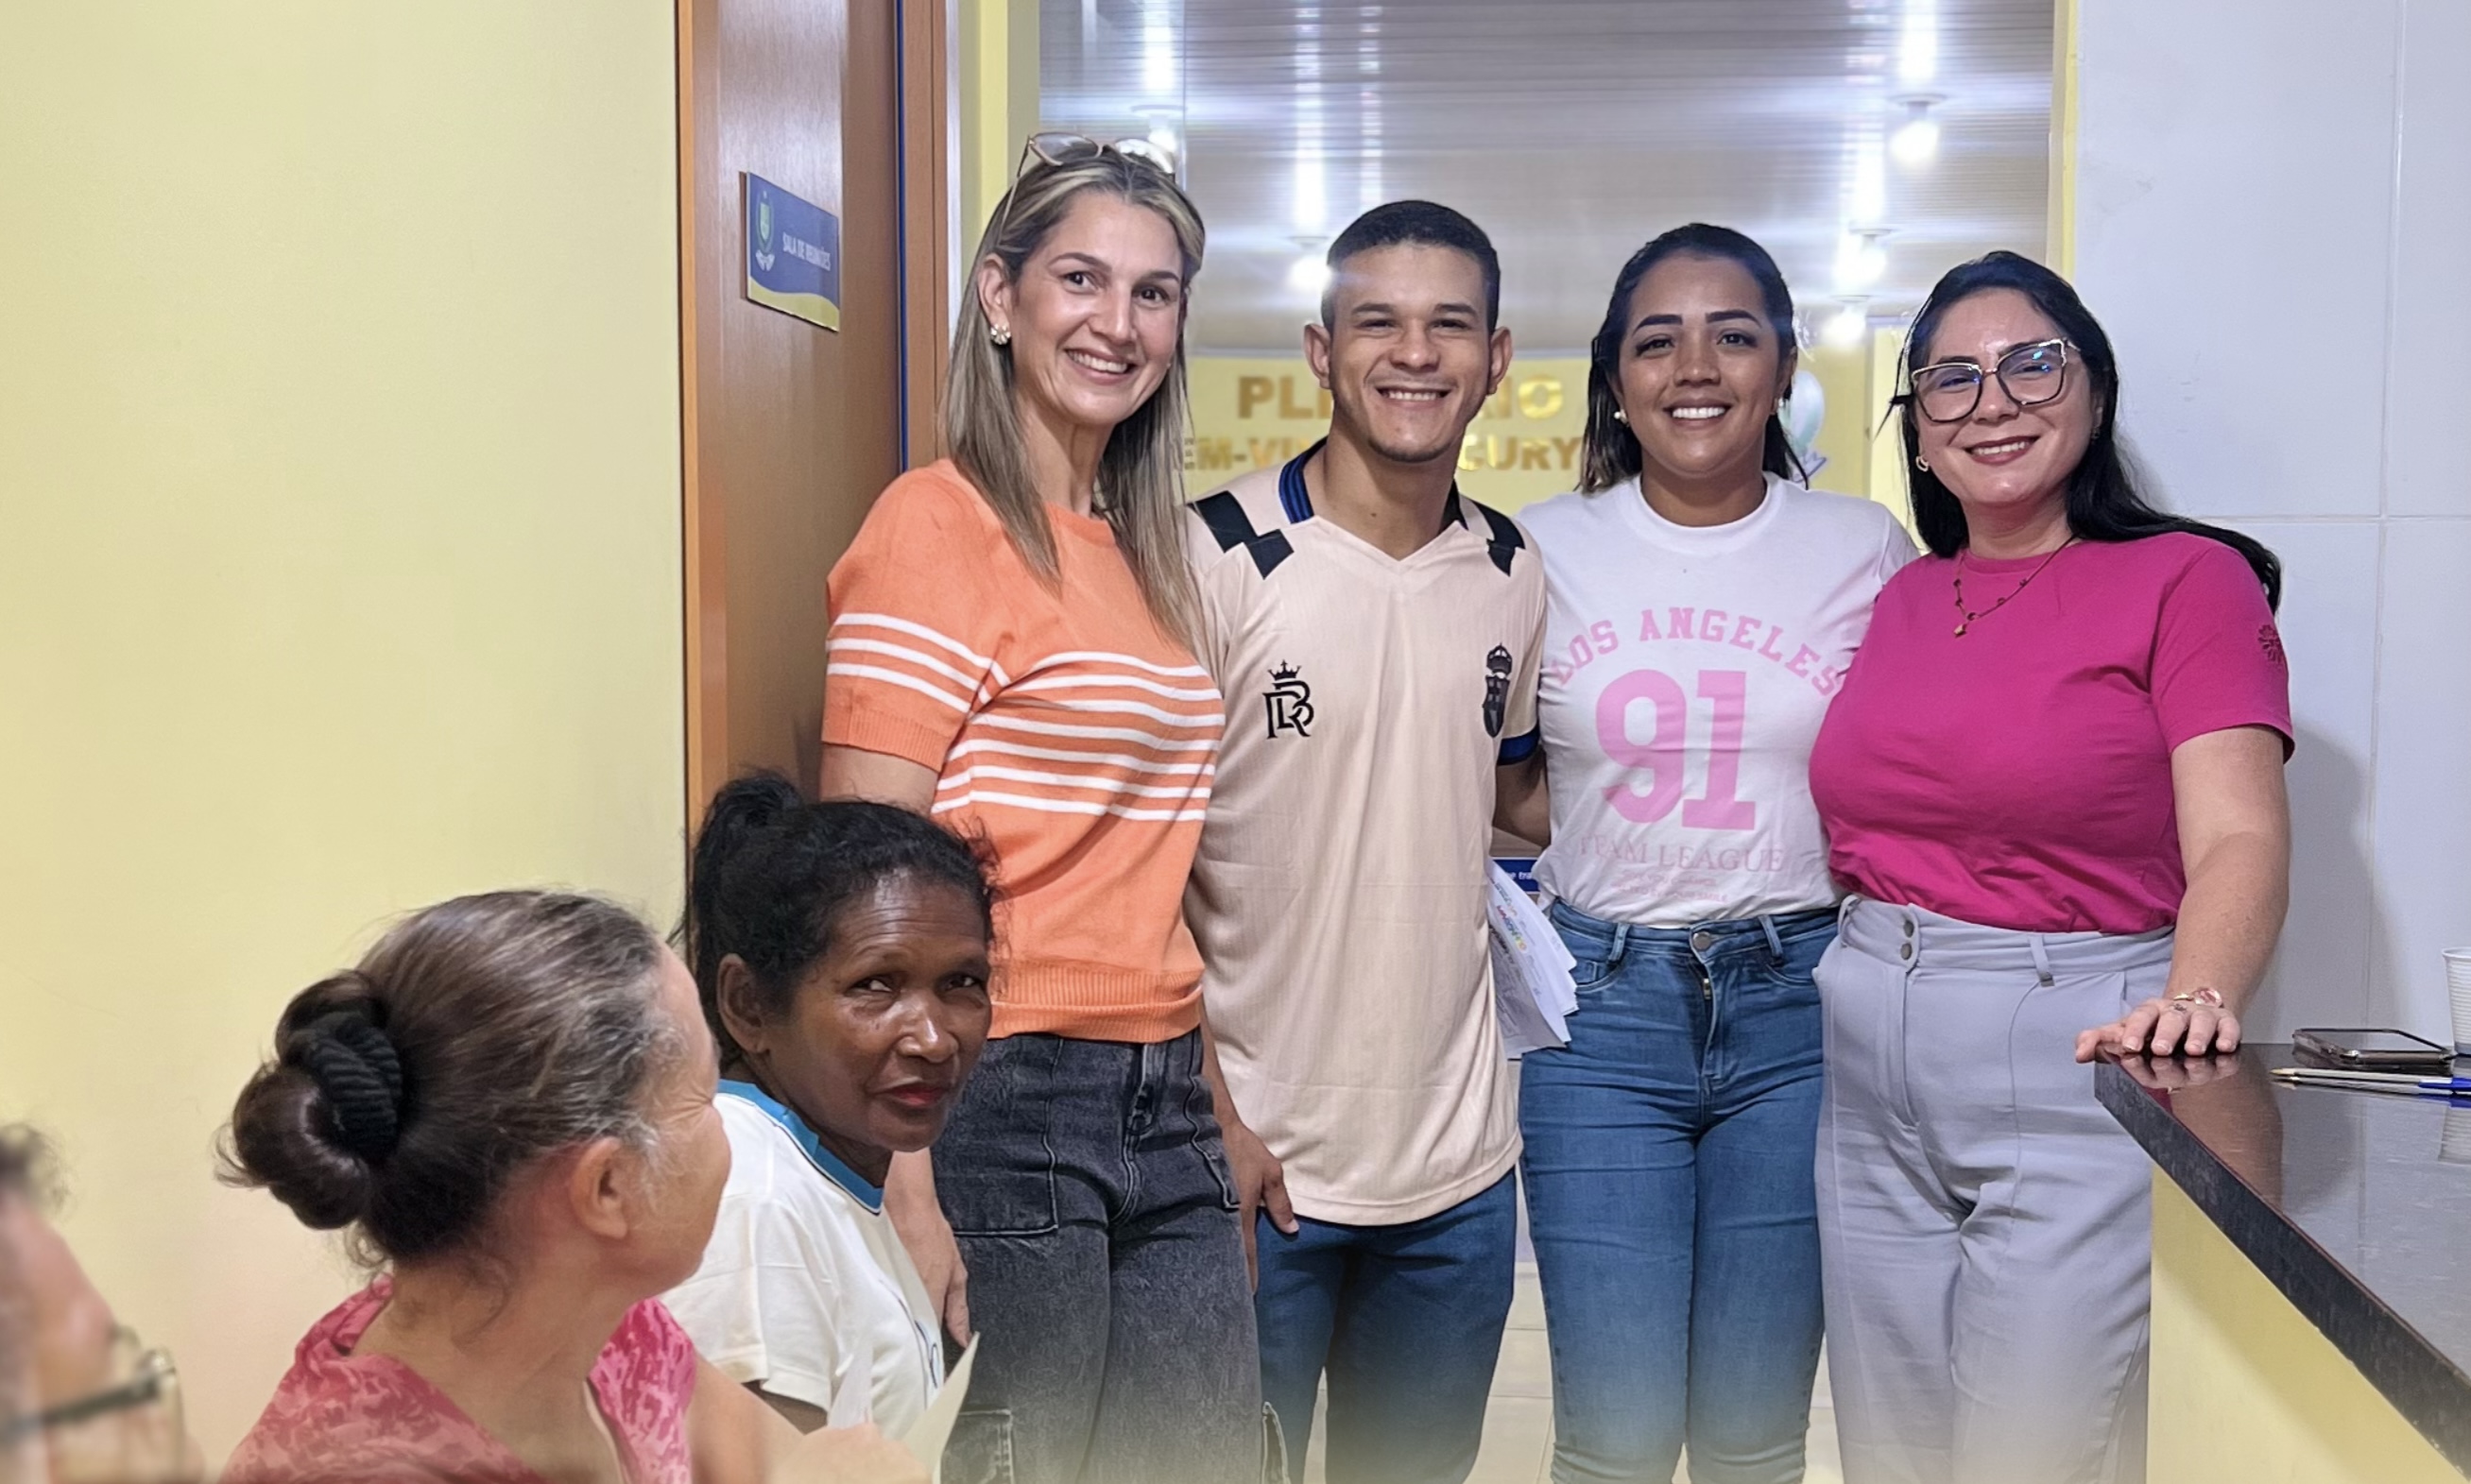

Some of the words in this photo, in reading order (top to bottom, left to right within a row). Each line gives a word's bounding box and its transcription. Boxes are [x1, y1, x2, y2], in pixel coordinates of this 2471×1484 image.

[782, 231, 797, 255] SALA
[798, 239, 805, 261] DE
[1458, 435, 1582, 470] CURY
[1551, 620, 1619, 687] LOS
[1639, 607, 1843, 696] ANGELES
[1595, 669, 1757, 830] 91
[1579, 835, 1648, 863] TEAM
[1658, 844, 1786, 873] LEAGUE
